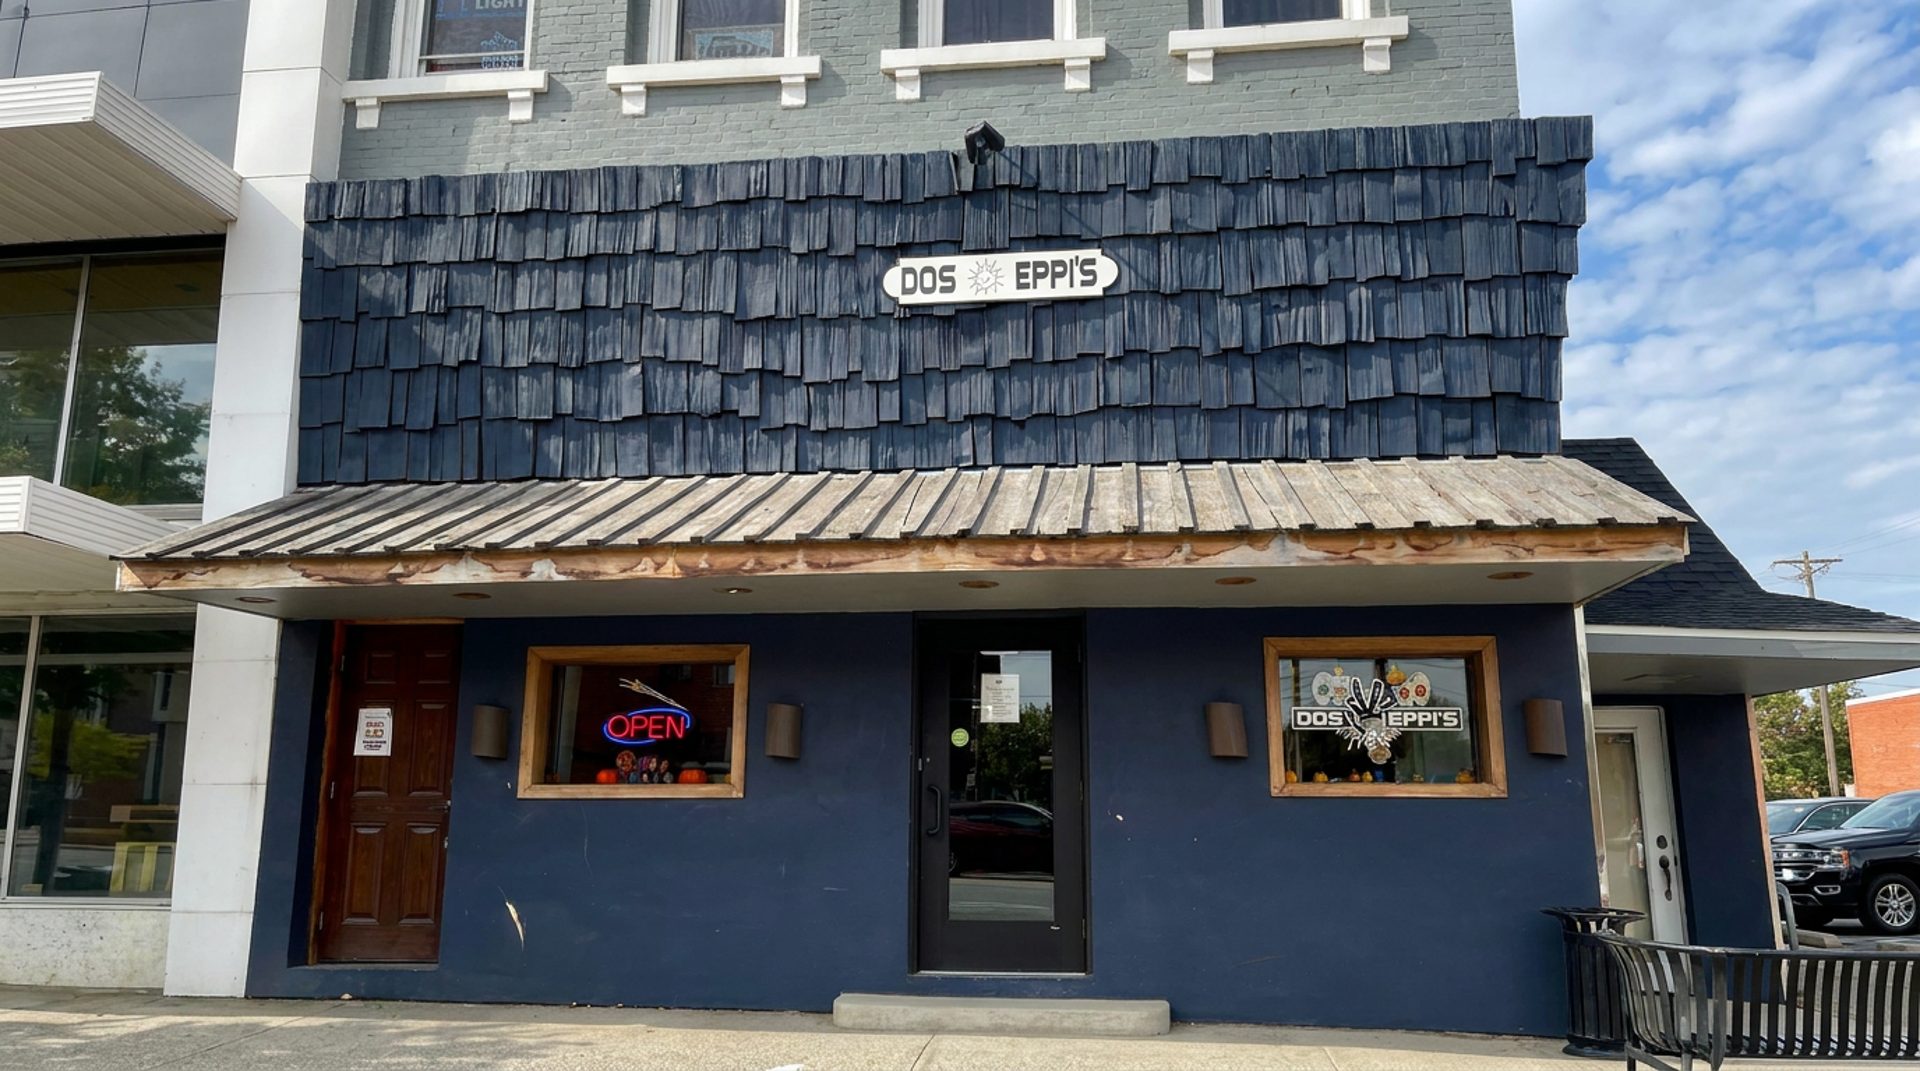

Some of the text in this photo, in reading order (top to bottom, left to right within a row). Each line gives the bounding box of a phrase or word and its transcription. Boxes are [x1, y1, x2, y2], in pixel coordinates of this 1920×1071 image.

[901, 255, 1098, 296] DOS EPPI'S
[607, 714, 685, 739] OPEN
[1297, 711, 1459, 727] DOS EPPI'S
